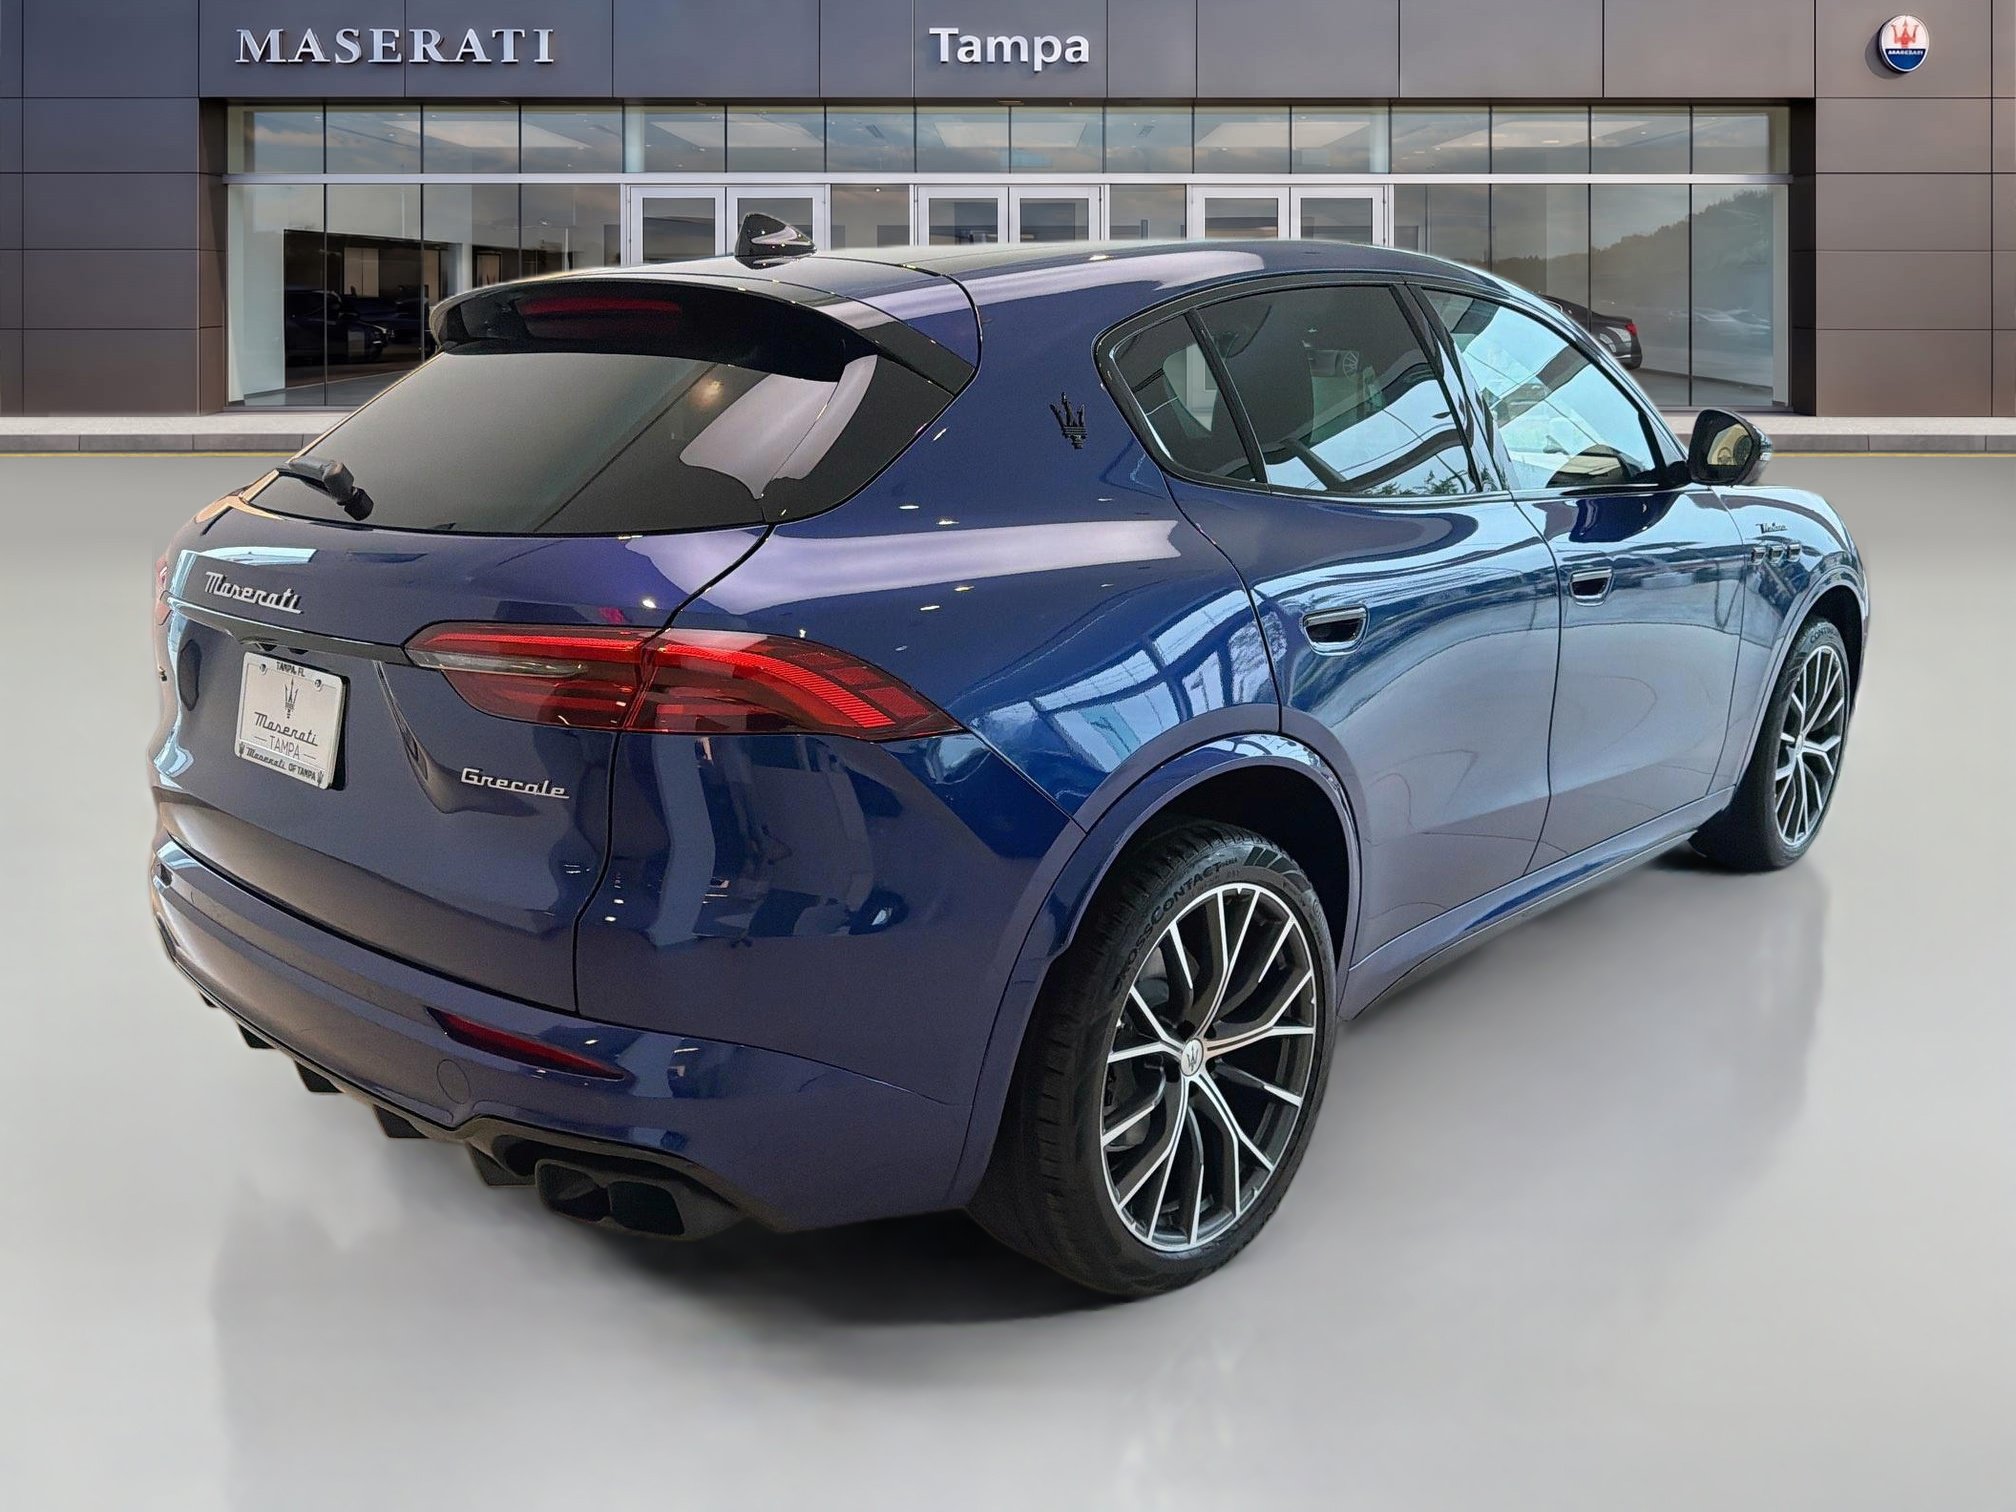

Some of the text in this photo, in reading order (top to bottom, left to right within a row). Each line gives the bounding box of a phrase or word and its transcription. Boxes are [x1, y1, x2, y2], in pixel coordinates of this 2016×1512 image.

[235, 28, 555, 64] MASERATI
[929, 27, 1089, 72] Tampa
[204, 571, 303, 614] Maserati
[297, 667, 305, 677] FL
[254, 711, 318, 747] Maserati
[246, 747, 317, 782] Maserati OF TAMPA
[269, 735, 300, 759] TAMPA
[460, 767, 570, 799] Grecale
